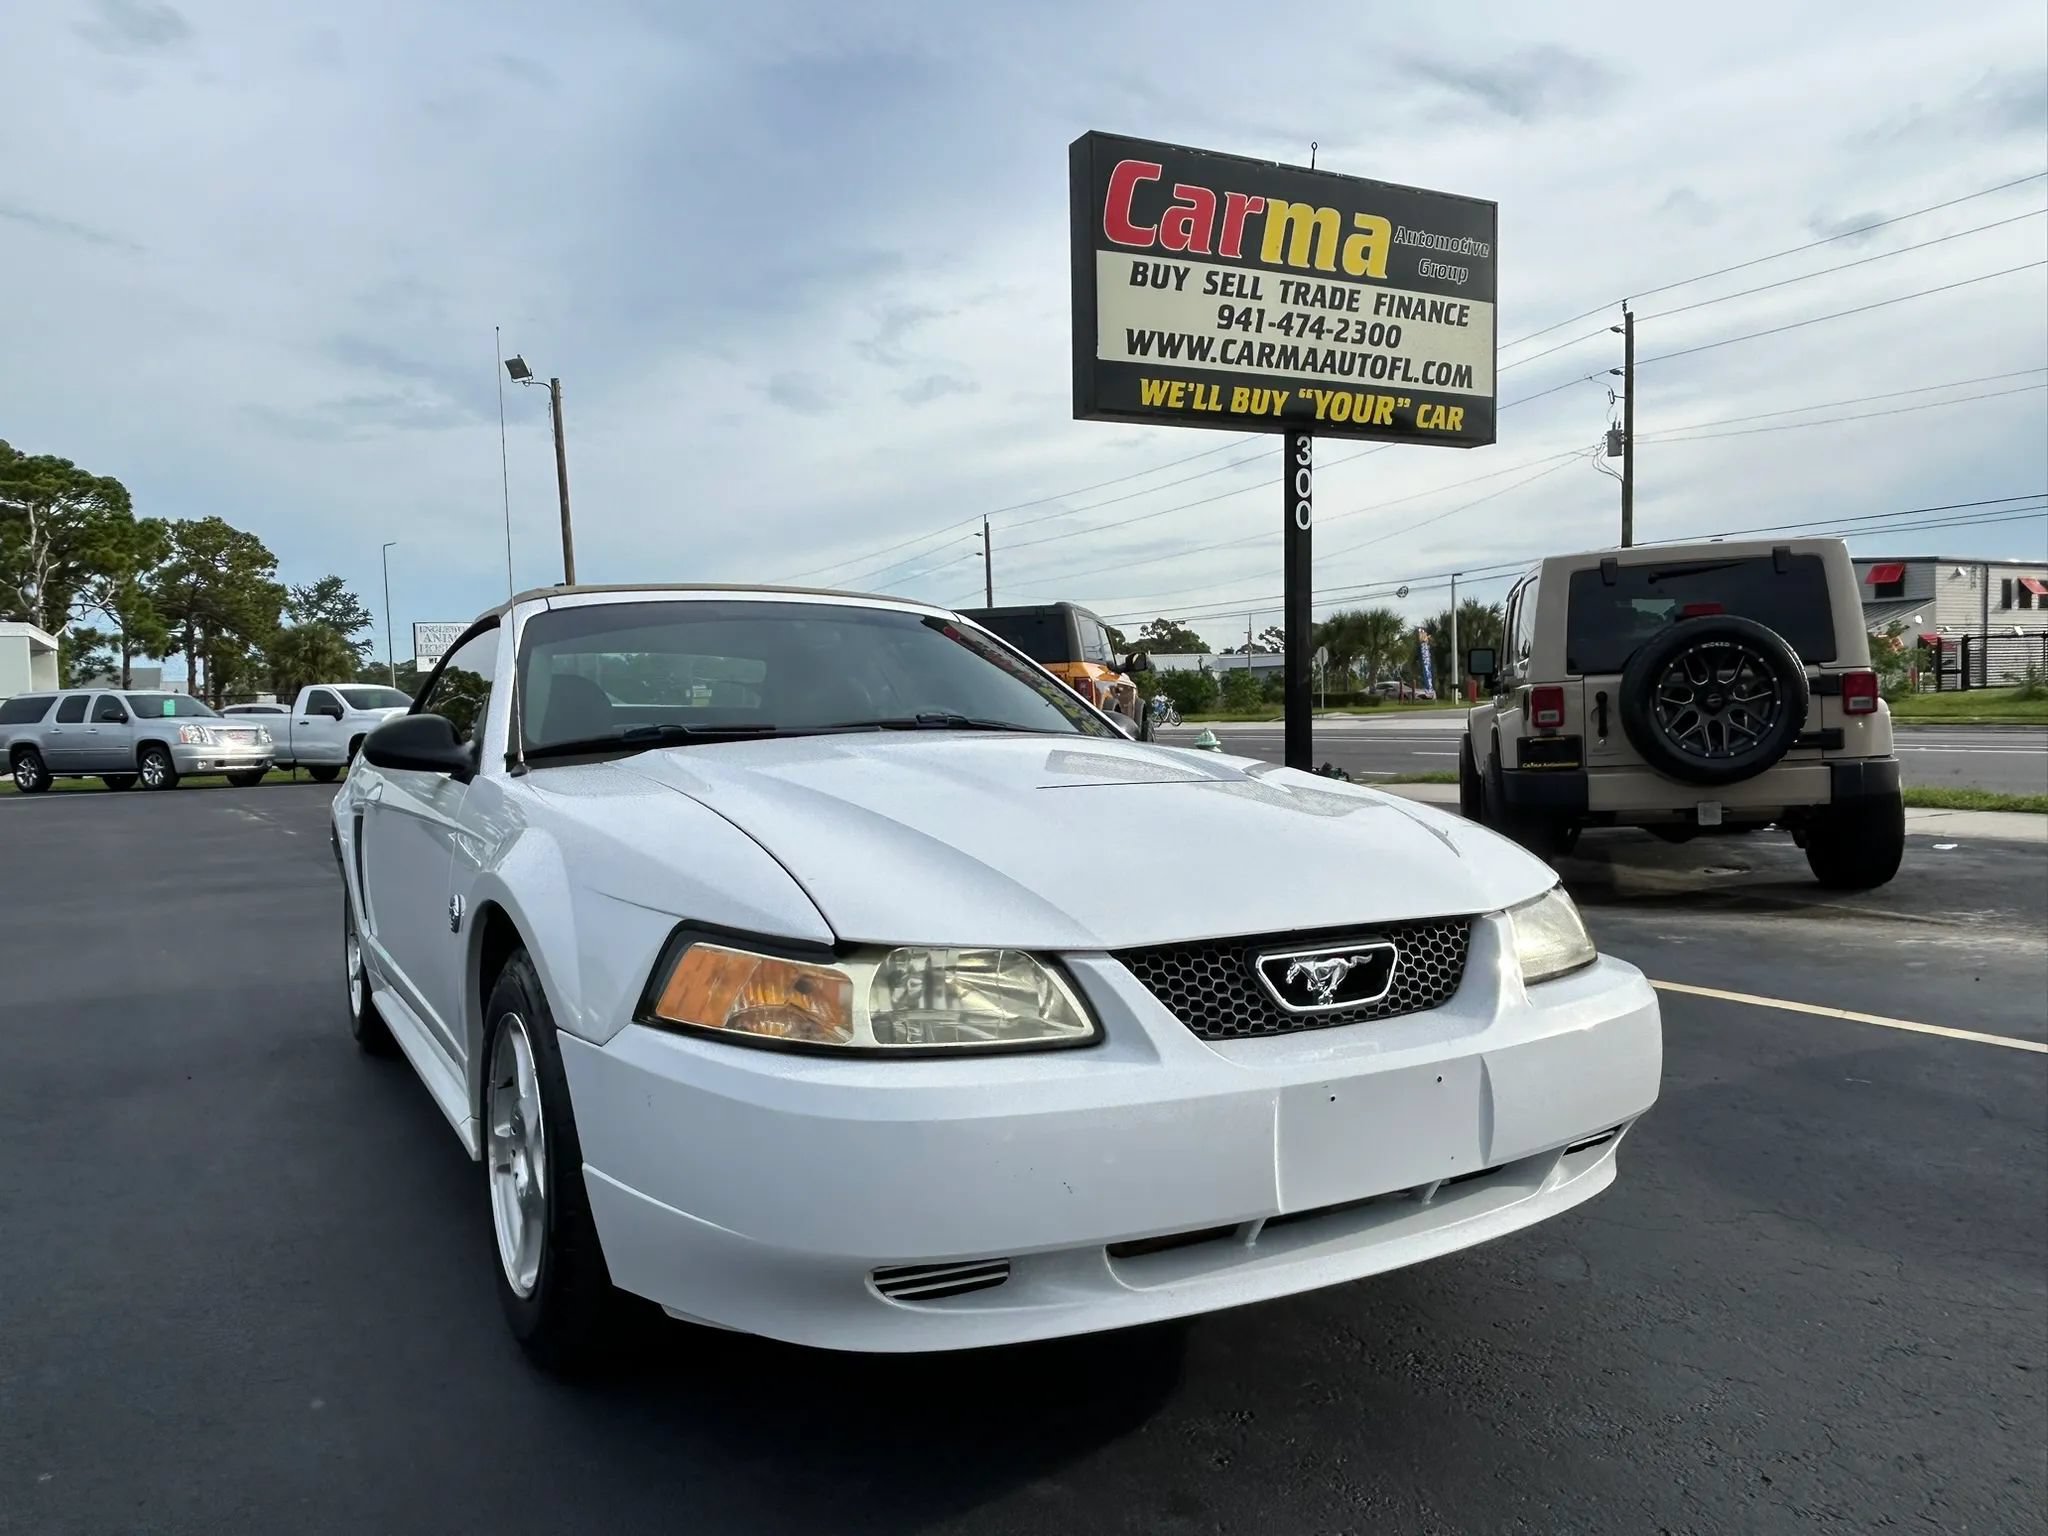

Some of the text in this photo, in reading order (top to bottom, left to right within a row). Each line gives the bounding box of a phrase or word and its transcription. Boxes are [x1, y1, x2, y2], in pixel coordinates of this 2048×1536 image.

[1103, 159, 1392, 279] Carma
[1393, 225, 1490, 258] Automotive
[1129, 260, 1470, 327] BUY SELL TRADE FINANCE
[1418, 258, 1469, 285] Group
[1216, 304, 1402, 349] 941-474-2300
[1126, 328, 1473, 389] WWW.CARMAAUTOFL.COM
[1140, 377, 1223, 412] WE'LL
[1230, 386, 1290, 417] BUY
[1416, 403, 1465, 432] CAR
[1295, 436, 1312, 530] 300
[418, 625, 468, 633] ENGLEW
[423, 633, 460, 643] ANIM
